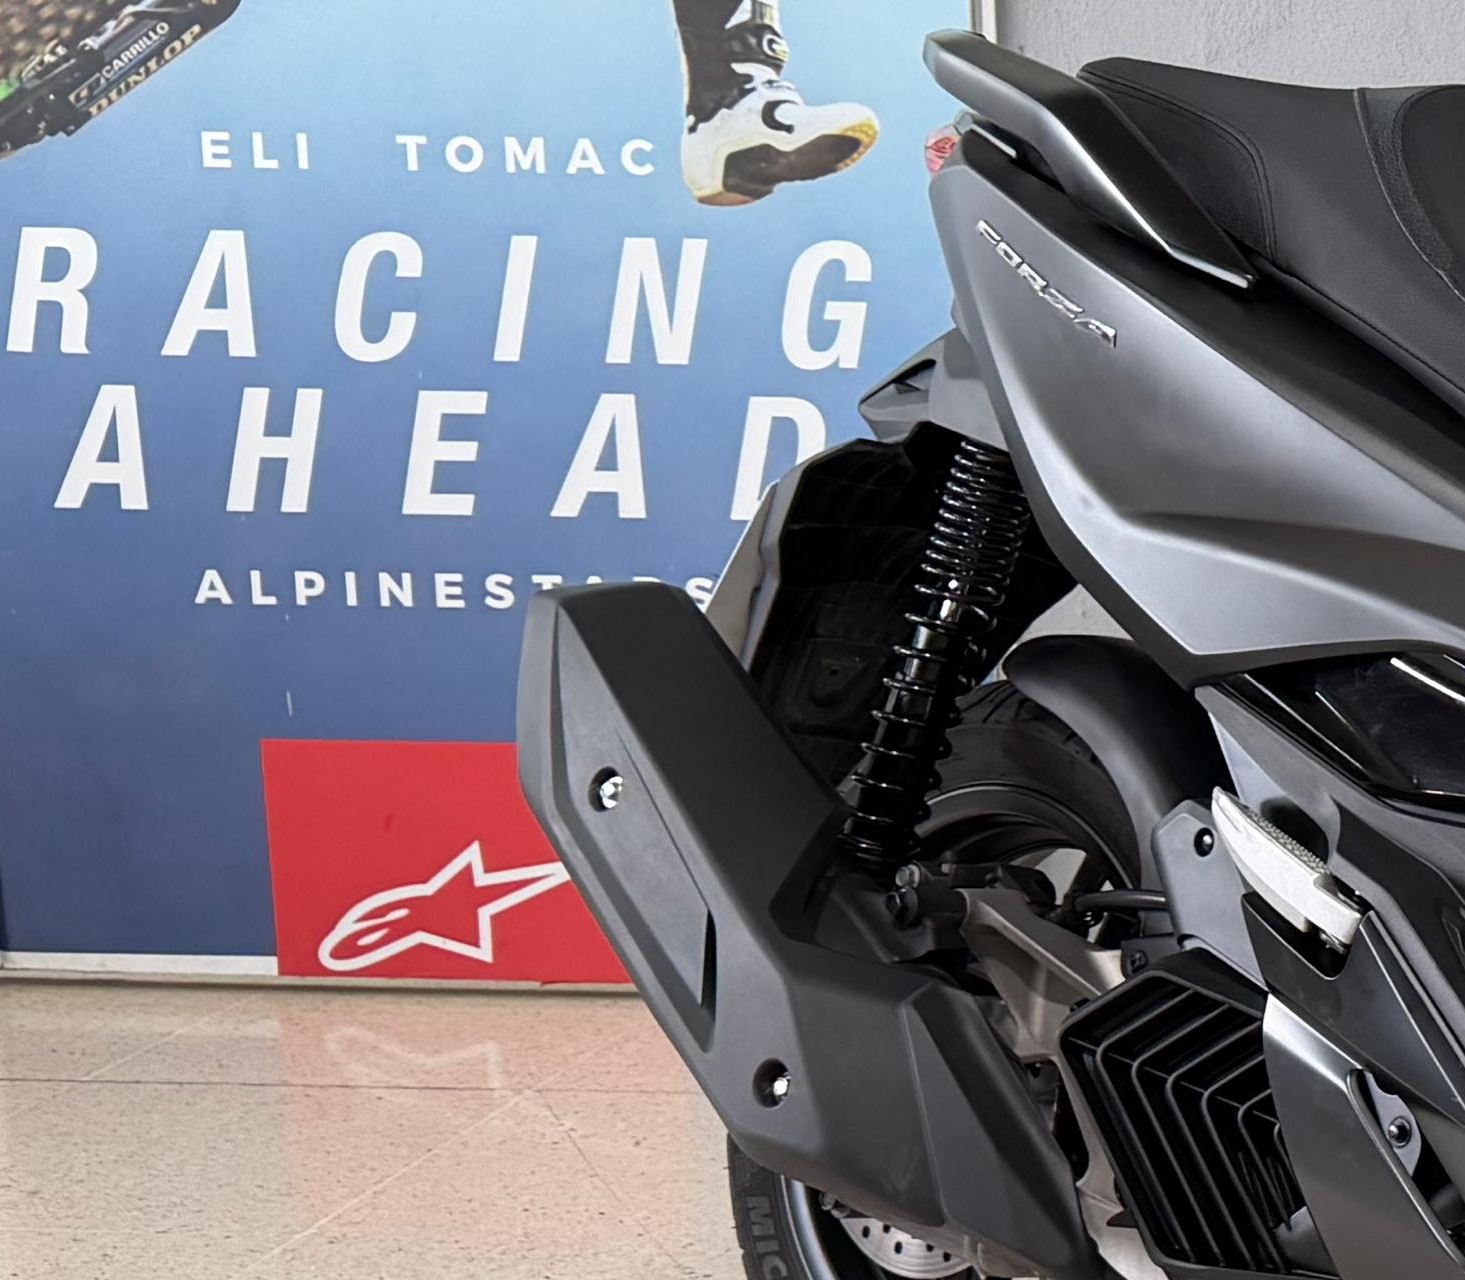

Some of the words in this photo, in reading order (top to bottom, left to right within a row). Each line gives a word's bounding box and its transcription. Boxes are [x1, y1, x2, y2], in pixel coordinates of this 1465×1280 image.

[88, 24, 202, 117] DUNLOP
[102, 21, 171, 80] CARRILLO
[201, 130, 311, 170] ELI
[396, 134, 656, 177] TOMAC
[6, 226, 873, 371] RACING
[54, 384, 827, 521] AHEAD
[194, 569, 715, 610] ALPINESTS
